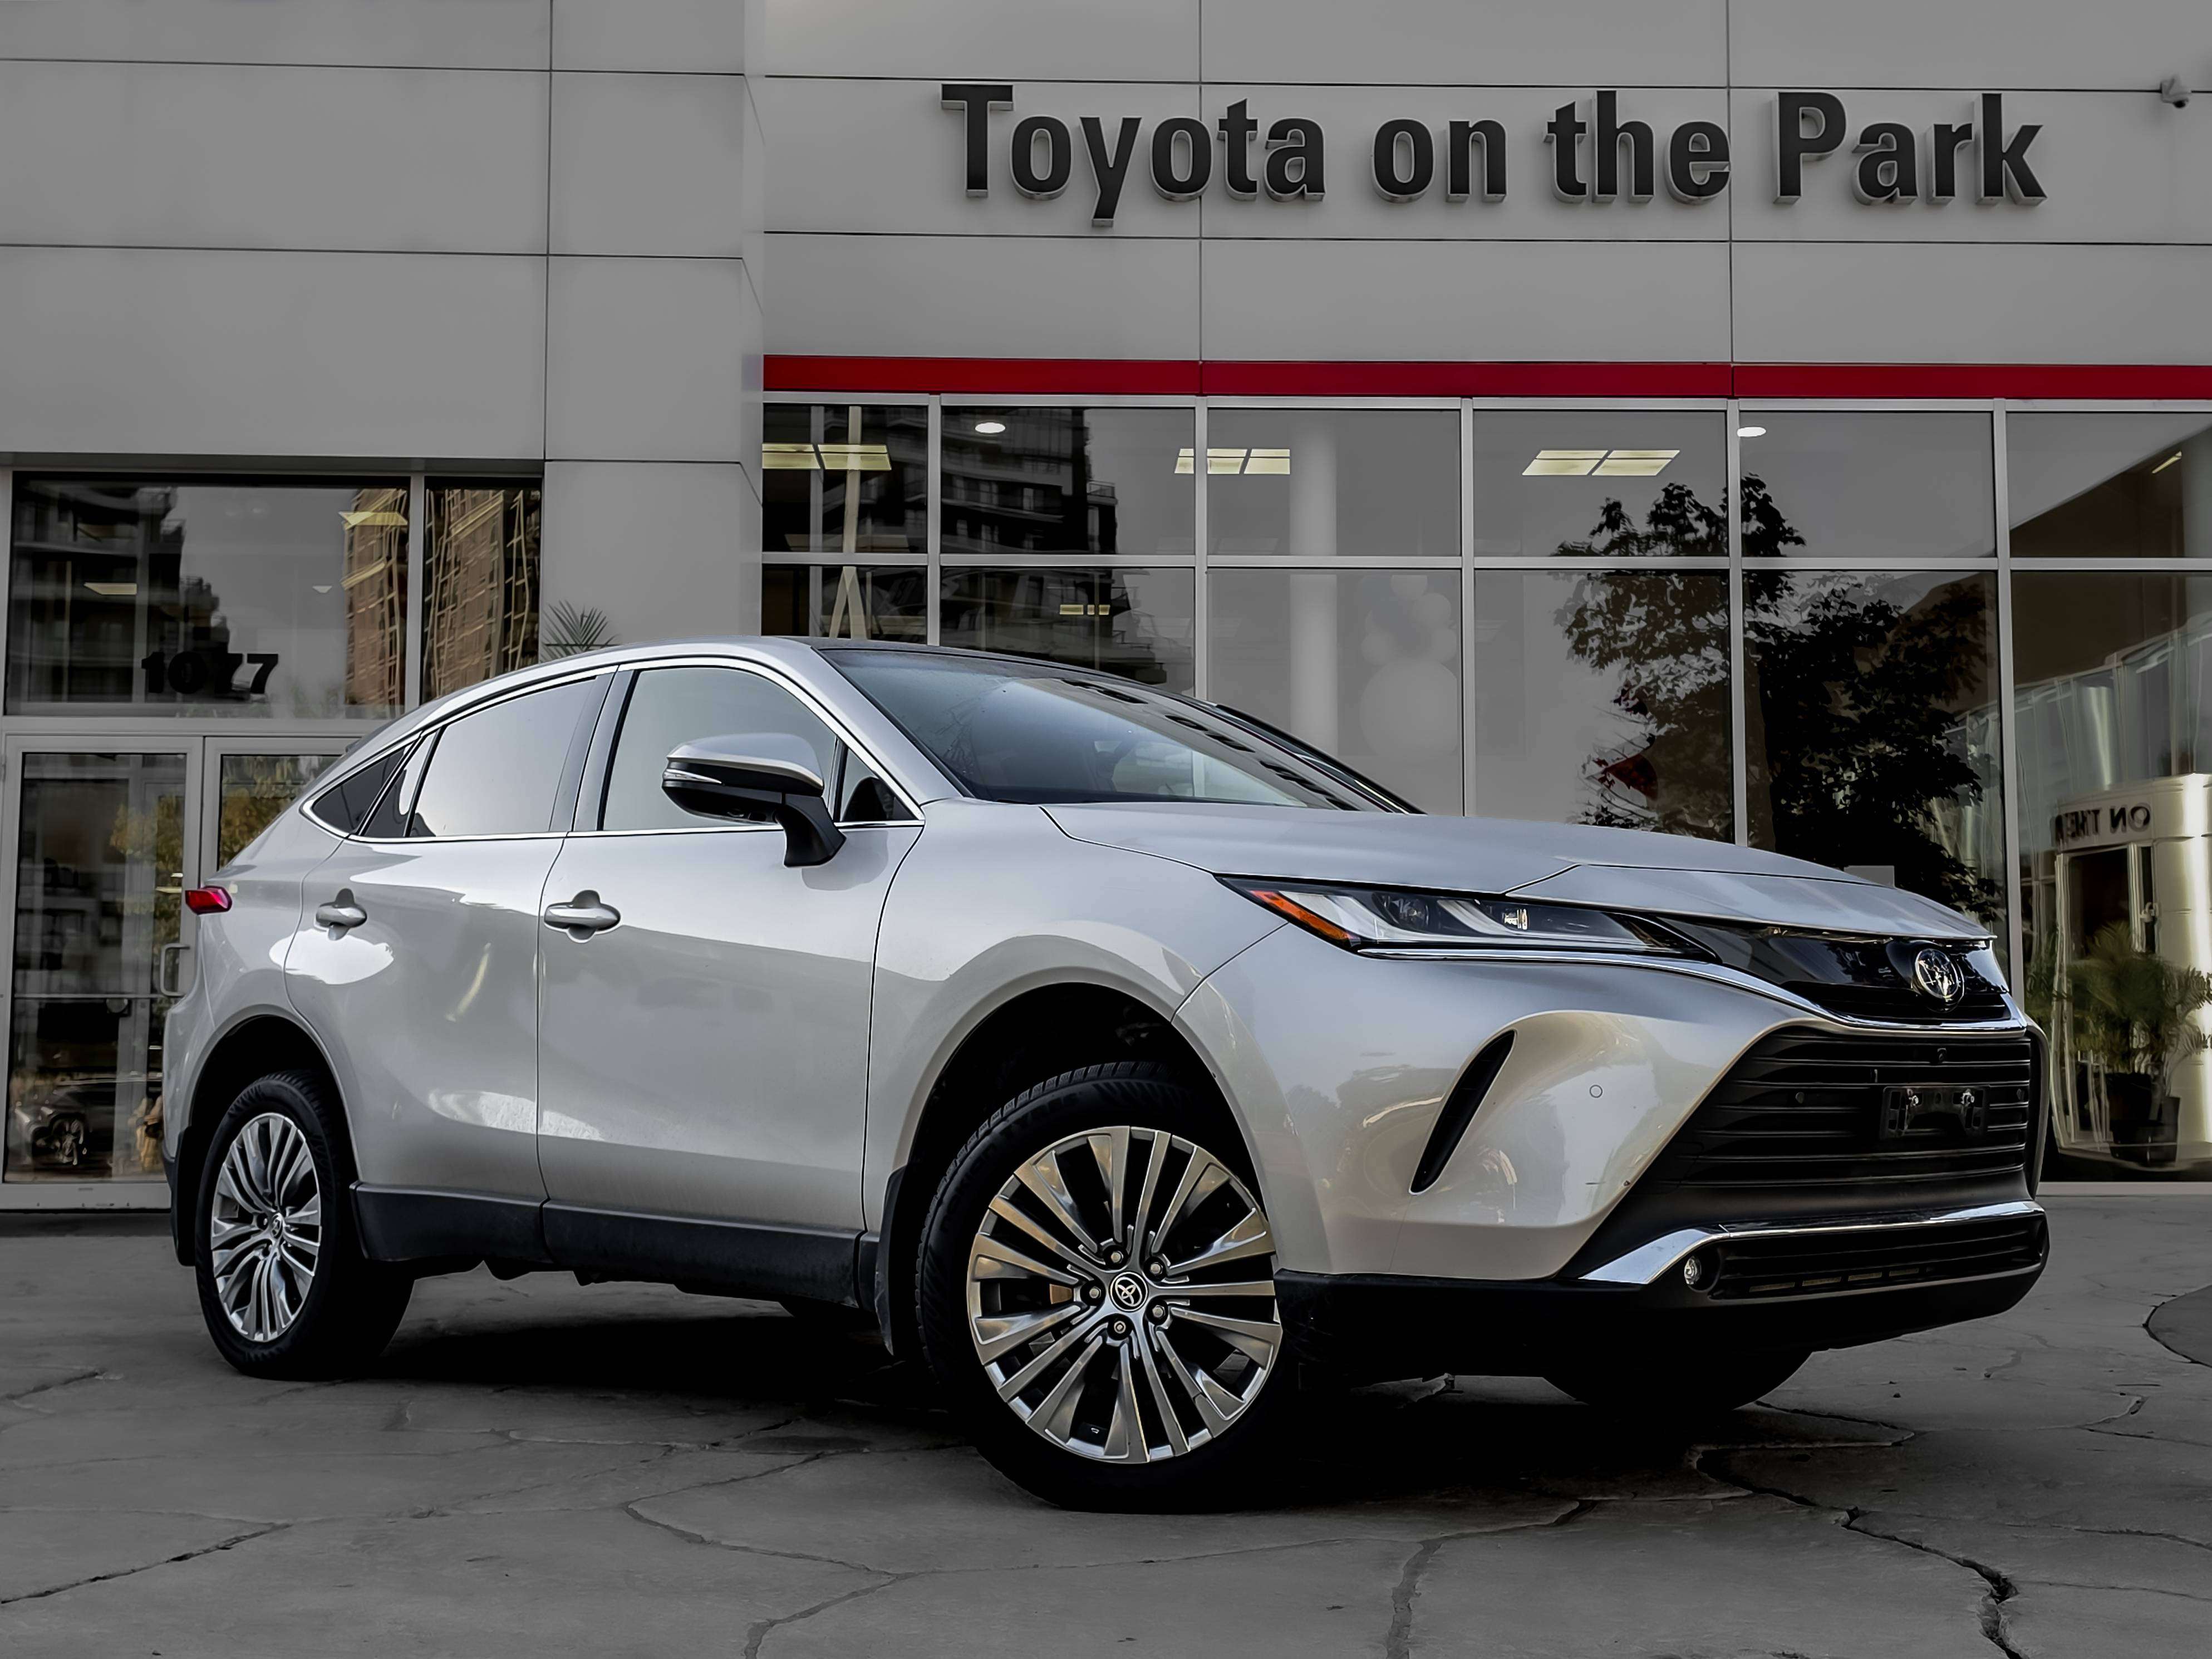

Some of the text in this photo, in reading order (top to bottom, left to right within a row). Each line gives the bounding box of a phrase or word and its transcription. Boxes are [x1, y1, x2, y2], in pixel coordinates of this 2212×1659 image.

[941, 84, 2047, 226] Toyota on the Park
[142, 652, 278, 694] 1077
